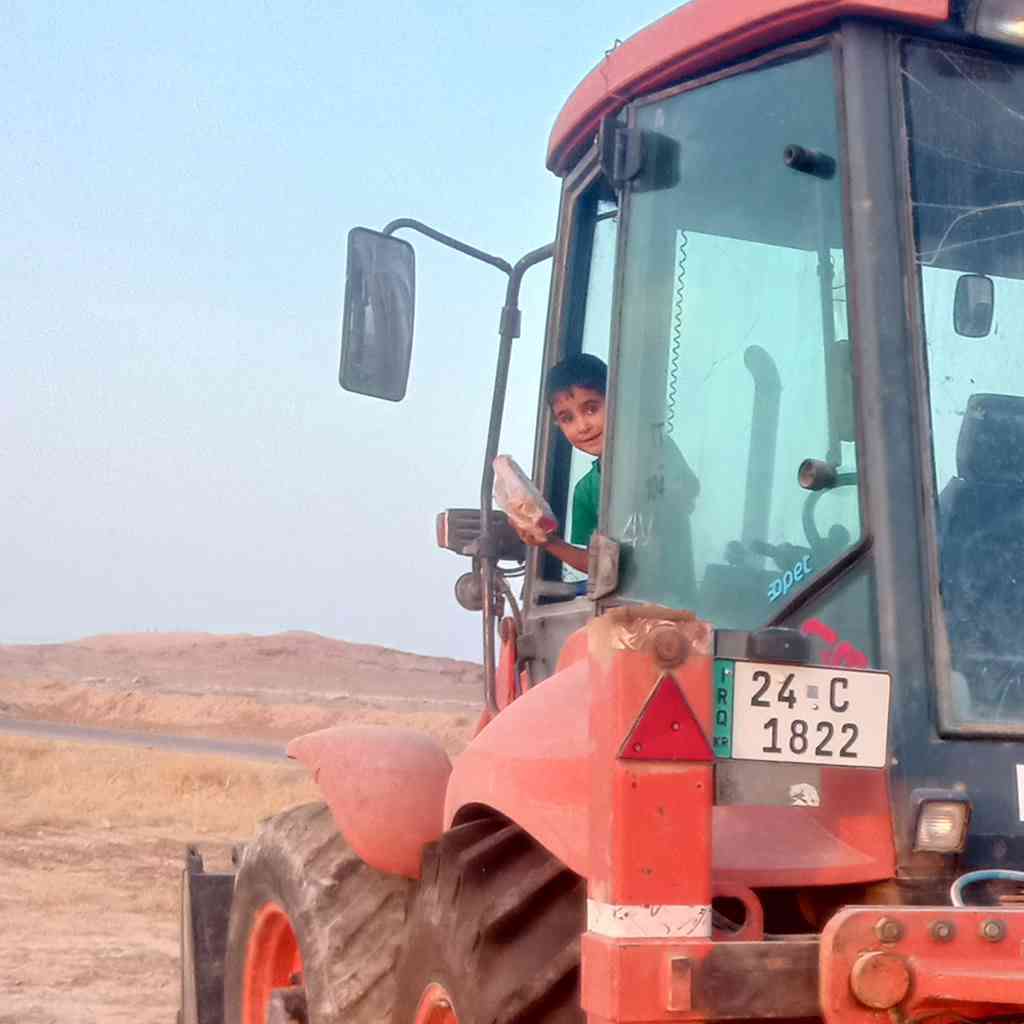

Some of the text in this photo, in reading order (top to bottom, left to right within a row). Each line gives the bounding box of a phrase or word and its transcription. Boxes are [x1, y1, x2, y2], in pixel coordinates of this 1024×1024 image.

[751, 670, 849, 712] 24 C
[763, 717, 859, 758] 1822
